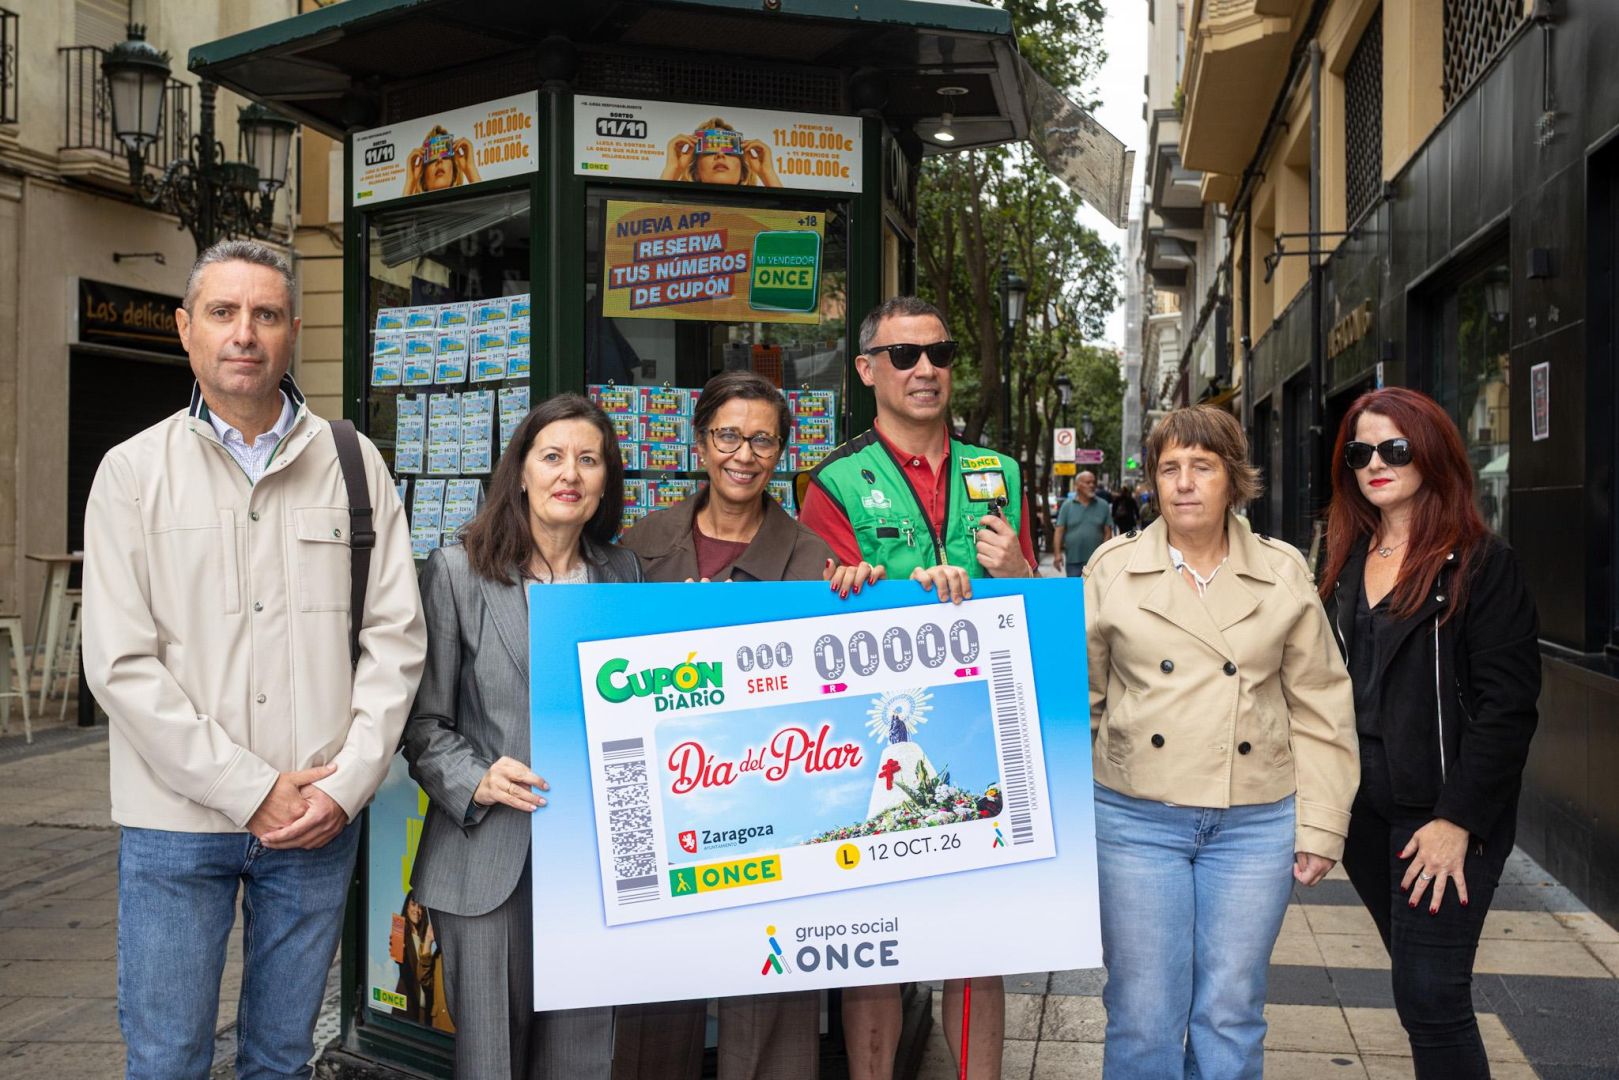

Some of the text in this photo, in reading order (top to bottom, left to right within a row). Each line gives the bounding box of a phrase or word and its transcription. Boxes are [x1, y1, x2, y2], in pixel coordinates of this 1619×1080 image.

[473, 112, 532, 140] 11.000.000€
[598, 120, 645, 137] 11/11
[773, 128, 854, 151] 11.000.000€
[365, 145, 394, 164] 11/11
[476, 141, 529, 167] 1.000.000€
[776, 156, 850, 178] 1.000.000€
[616, 211, 711, 238] NUEVA APP
[797, 215, 817, 227] +18
[639, 233, 723, 259] RESERVA
[613, 252, 747, 284] TUS NÚMEROS
[756, 255, 815, 265] MI VENDEDOR
[758, 269, 810, 286] ONCE
[635, 275, 730, 306] DE CUPÓN
[86, 295, 177, 332] Las delicia
[970, 458, 999, 468] ONCE
[736, 614, 1015, 681] 000 00000 2€
[596, 651, 723, 704] CUPÓN
[747, 675, 789, 694] SERIE
[965, 668, 972, 676] R
[829, 684, 836, 693] R
[668, 724, 863, 794] Día del Pilar
[702, 823, 774, 847] Zaragoza
[843, 832, 961, 865] L 12 OCT. 26
[702, 859, 776, 888] ONCE
[795, 917, 898, 942] grupo social
[796, 939, 899, 972] ONCE
[382, 993, 405, 1007] ONCE
